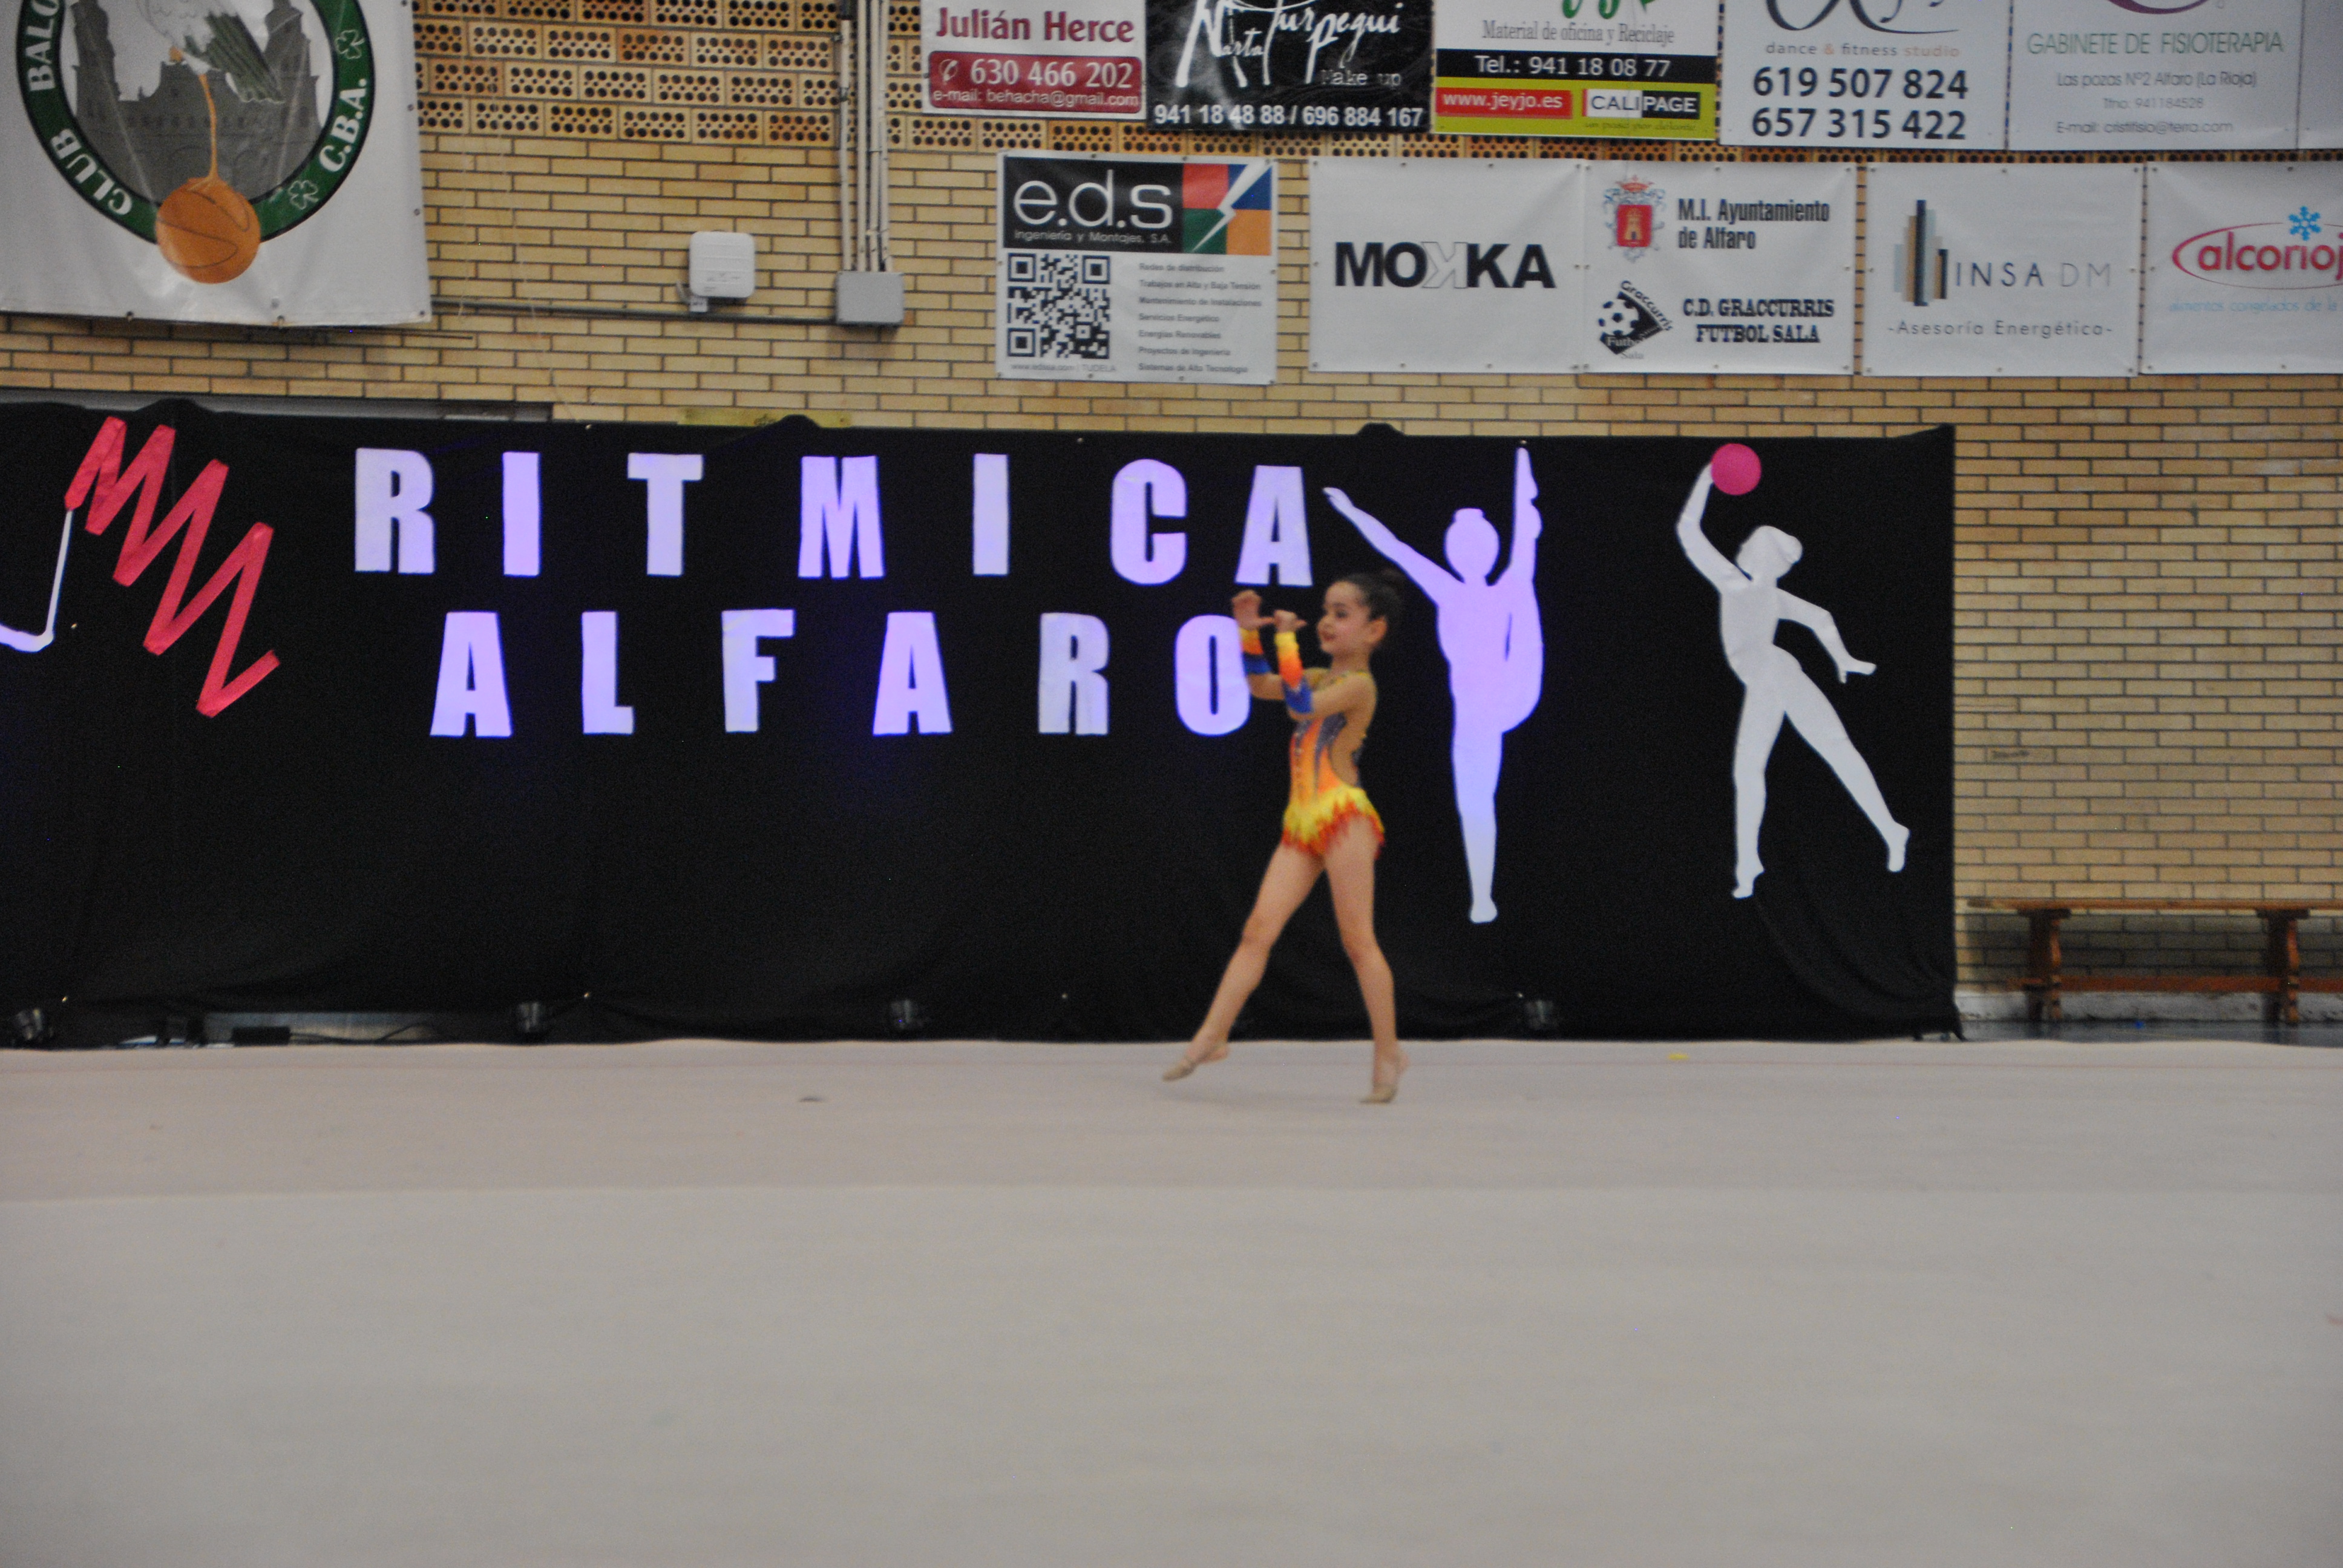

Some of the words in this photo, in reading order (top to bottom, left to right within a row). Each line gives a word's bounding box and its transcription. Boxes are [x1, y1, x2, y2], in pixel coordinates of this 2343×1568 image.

[936, 7, 1031, 40] Julián
[1044, 11, 1134, 42] Herce
[1483, 20, 1538, 40] Material
[1543, 23, 1556, 40] de
[1561, 22, 1603, 41] oficina
[1607, 30, 1614, 45] y
[1619, 24, 1675, 47] Reciclaje
[1766, 42, 1816, 55] dance
[1824, 44, 1835, 54] &
[1841, 43, 1896, 56] fitness
[1904, 45, 1959, 57] studio
[2027, 33, 2119, 54] GABINETE
[2126, 33, 2150, 53] DE
[2162, 31, 2284, 53] FISIOTERAPIA
[971, 59, 1019, 85] 630
[1028, 61, 1076, 87] 466
[1086, 62, 1133, 88] 202
[1474, 55, 1520, 73] Tel.:
[1529, 56, 1567, 74] 941
[1579, 59, 1603, 75] 18
[1611, 59, 1637, 76] 08
[1645, 60, 1670, 77] 77
[1754, 67, 1817, 96] 619
[1829, 68, 1892, 97] 507
[1903, 70, 1968, 99] 824
[2058, 72, 2078, 86] Las
[2155, 72, 2192, 86] Alfaro
[933, 90, 981, 102] e-mail:
[987, 89, 1138, 107] behacha@gmail.com
[1444, 92, 1563, 110] www.jeyjo.es
[319, 77, 367, 172] C.B.A.
[1155, 105, 1190, 123] 941
[1199, 105, 1223, 123] 18
[1229, 105, 1254, 124] 48
[1260, 106, 1285, 124] 88
[1302, 106, 1340, 126] 696
[1344, 107, 1381, 126] 884
[1388, 108, 1423, 126] 167
[1752, 108, 1816, 137] 657
[1827, 108, 1890, 139] 315
[1902, 109, 1965, 139] 422
[51, 128, 133, 215] CLUB
[1678, 198, 1711, 221] M.I.
[1717, 199, 1829, 224] Ayuntamiento
[1678, 227, 1697, 248] de
[1703, 227, 1756, 249] Alfaro
[1956, 263, 2043, 287] INSA
[2061, 263, 2110, 287] DM
[1683, 298, 1714, 316] C.D.
[1718, 299, 1834, 317] GRACCURRIS
[1696, 324, 1769, 342] FUTBOL
[1773, 325, 1820, 343] SALA
[355, 448, 1312, 587] RITMICA
[430, 609, 1250, 736] ALFARO
